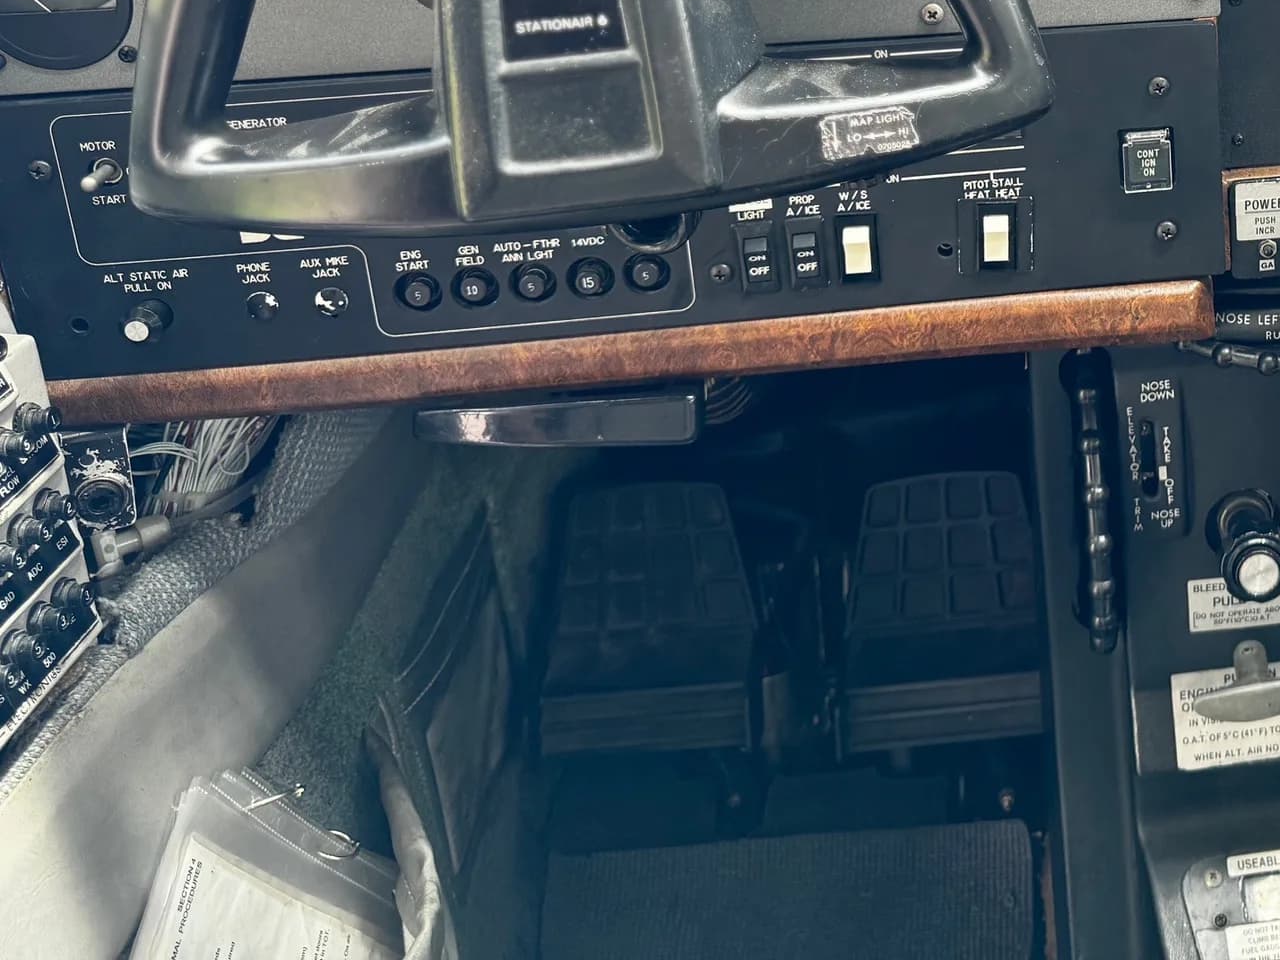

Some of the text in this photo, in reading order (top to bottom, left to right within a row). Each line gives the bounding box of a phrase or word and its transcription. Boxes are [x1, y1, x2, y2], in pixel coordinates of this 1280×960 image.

[515, 16, 593, 34] STATIONAIR
[80, 140, 116, 151] MOTOR
[1136, 148, 1160, 160] CONT
[1141, 159, 1156, 168] IGN
[1142, 168, 1156, 177] ON
[963, 177, 1023, 189] PITOT STALL
[92, 194, 126, 206] START
[1254, 216, 1276, 226] PUSH
[1255, 226, 1275, 235] INCR
[400, 250, 421, 260] ENG
[458, 245, 479, 256] GEN
[300, 256, 348, 269] AUX MIKE
[395, 260, 429, 271] START
[456, 256, 484, 266] FIELD
[236, 262, 270, 274] PHONE
[312, 266, 341, 278] JACK
[103, 268, 188, 284] ALT STATIC AIR
[242, 272, 271, 284] JACK
[124, 280, 172, 294] PULL ON
[1215, 312, 1251, 326] NOSE
[1141, 380, 1170, 392] NOSE
[1141, 390, 1174, 403] DOWN
[1127, 407, 1143, 531] ELEVATOR TRIM
[1151, 508, 1180, 520] NOSE
[1161, 519, 1173, 528] UP
[1194, 751, 1222, 761] WHEN
[1248, 746, 1262, 755] AIR
